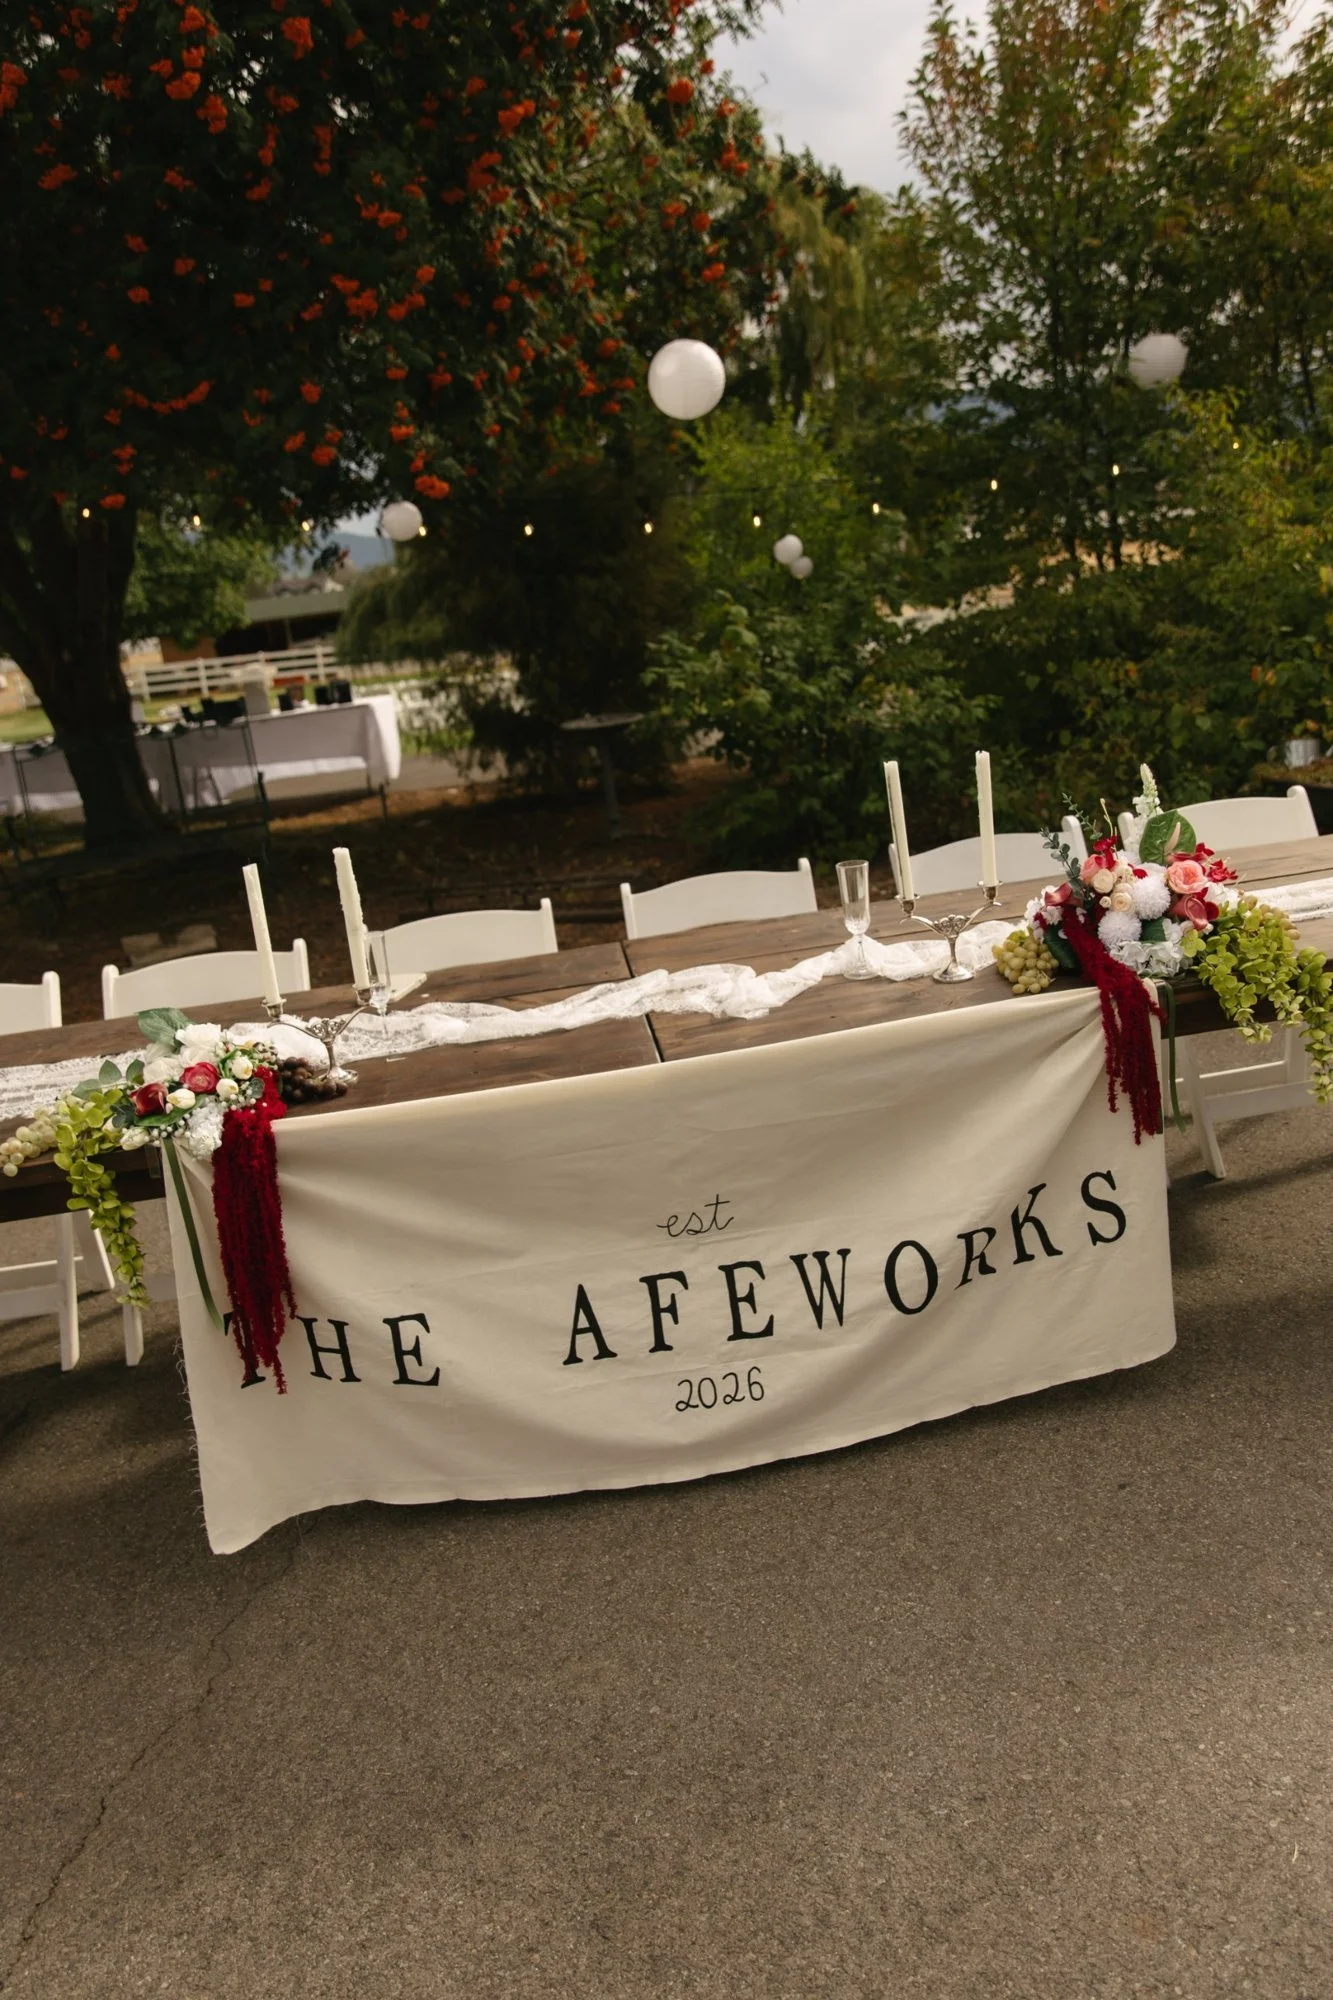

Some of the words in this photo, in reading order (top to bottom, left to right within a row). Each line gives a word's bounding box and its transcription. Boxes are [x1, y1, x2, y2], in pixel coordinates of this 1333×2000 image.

[657, 1193, 735, 1237] est
[562, 1169, 1128, 1366] AFEWORKS
[675, 1366, 765, 1412] 2026
